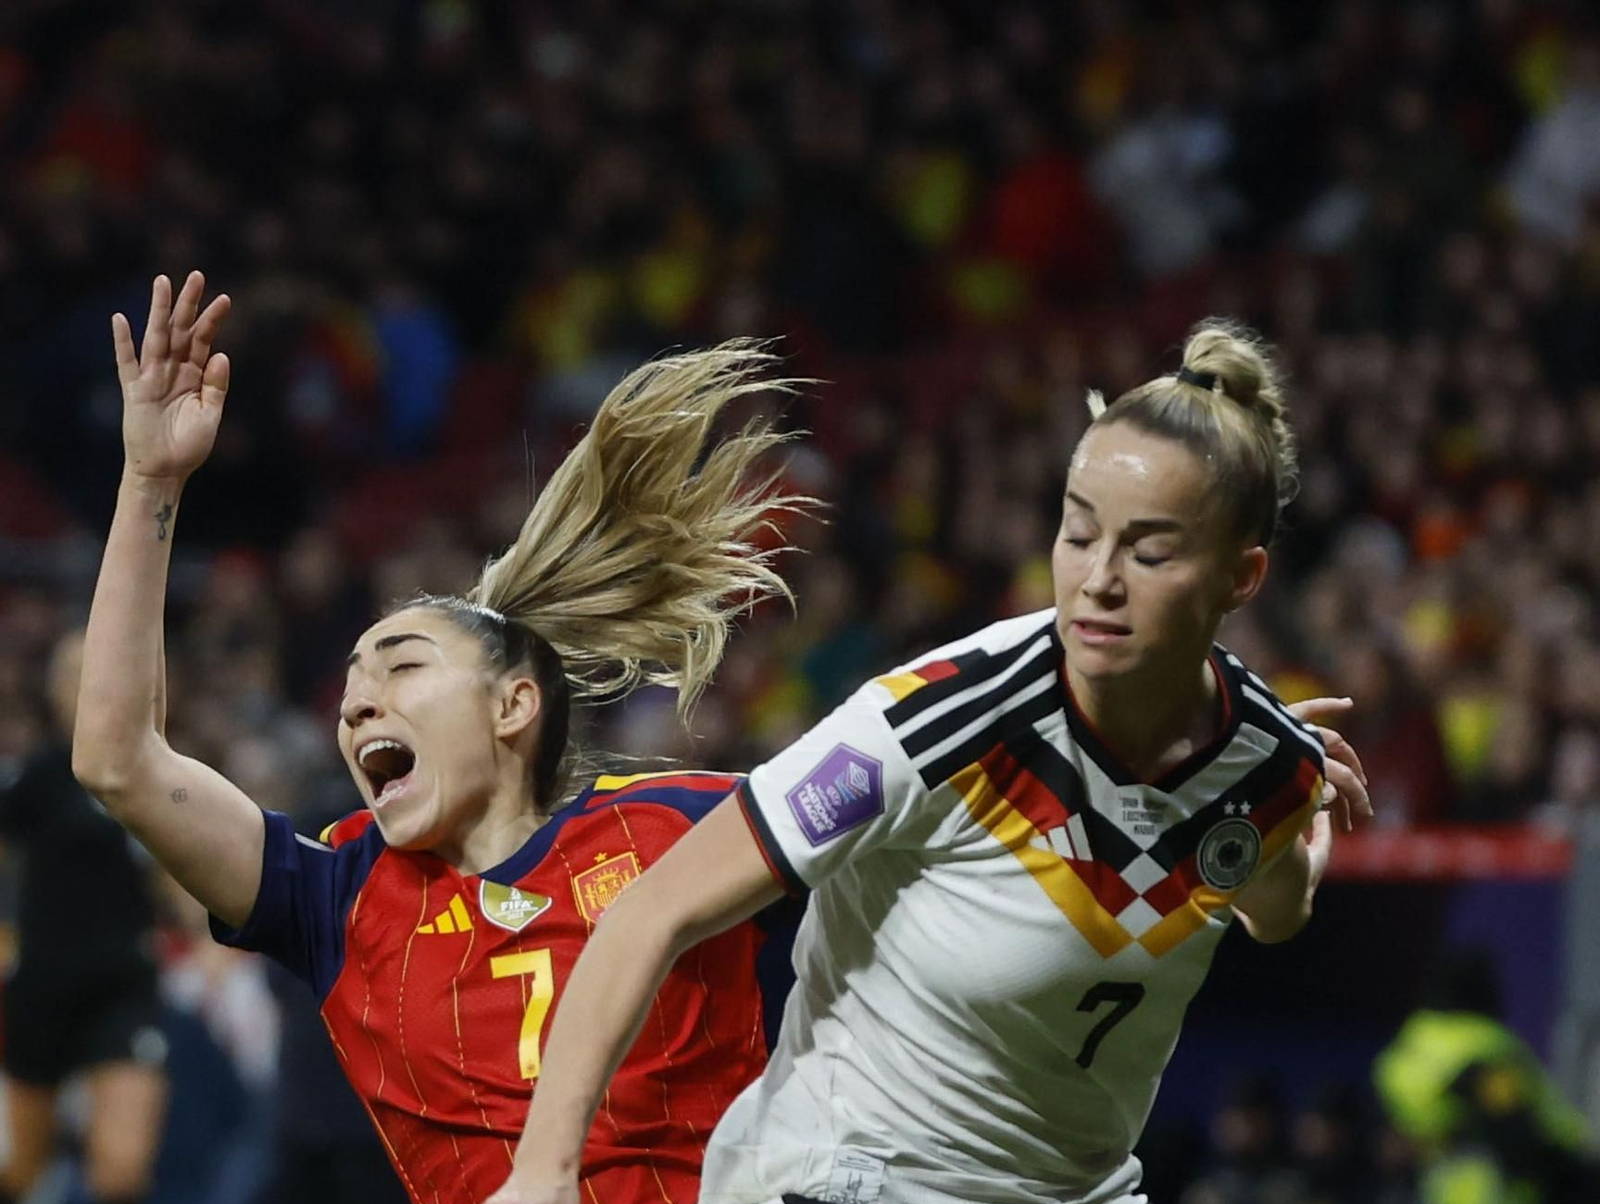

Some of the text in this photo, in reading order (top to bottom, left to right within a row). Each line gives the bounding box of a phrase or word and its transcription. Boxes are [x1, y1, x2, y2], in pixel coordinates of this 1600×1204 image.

[797, 790, 827, 834] LEAGUE
[804, 782, 837, 831] NATIONS
[500, 900, 531, 912] FIFA
[490, 948, 554, 1080] 7
[1075, 981, 1146, 1069] 7
